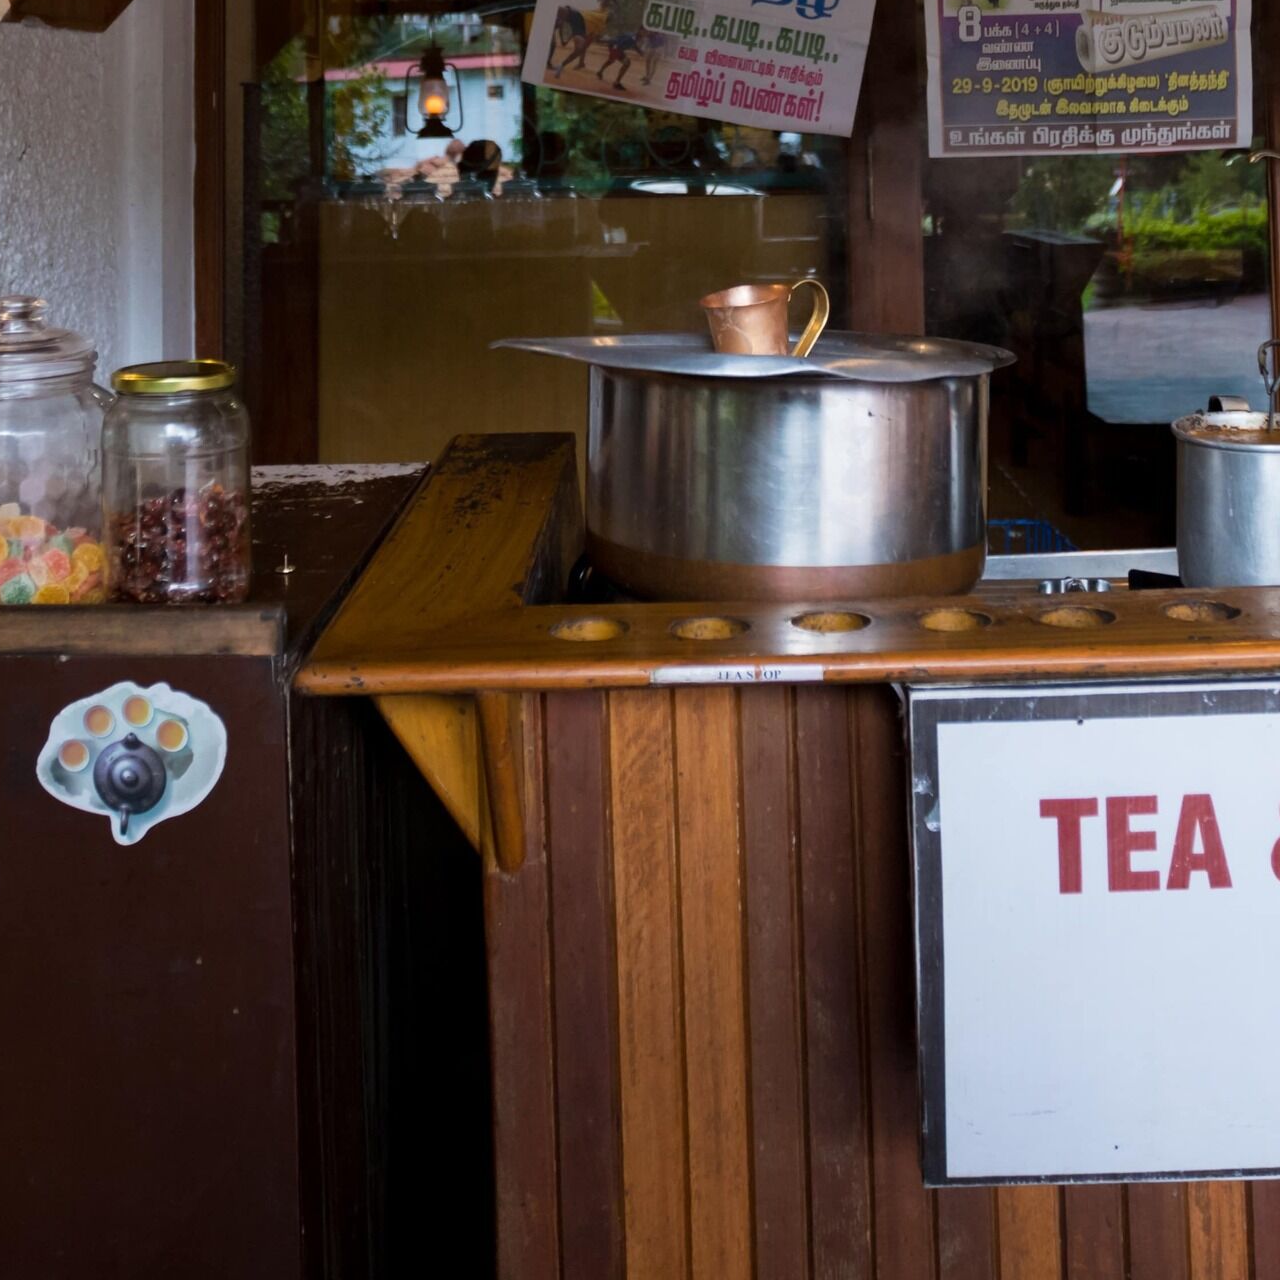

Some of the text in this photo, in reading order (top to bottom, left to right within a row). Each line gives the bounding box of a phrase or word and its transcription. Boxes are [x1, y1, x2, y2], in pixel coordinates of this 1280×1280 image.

[958, 4, 1012, 42] 8 பக்க
[982, 40, 1033, 53] வண்ண
[678, 47, 823, 87] கபடி விளையாட்டில் சாதிக்கும்
[976, 55, 1041, 71] இணைப்பு
[665, 69, 824, 122] தமிழ்ப் பெண்கள்!
[1044, 74, 1160, 97] (ஞாயிற்றுக்கிழமை)
[995, 94, 1189, 120] இதழுடன் இலவசமாக கிடைக்கும்
[949, 120, 1231, 149] உங்கள் பிரதிக்கு முந்துங்கள்
[1038, 793, 1233, 894] TEA
